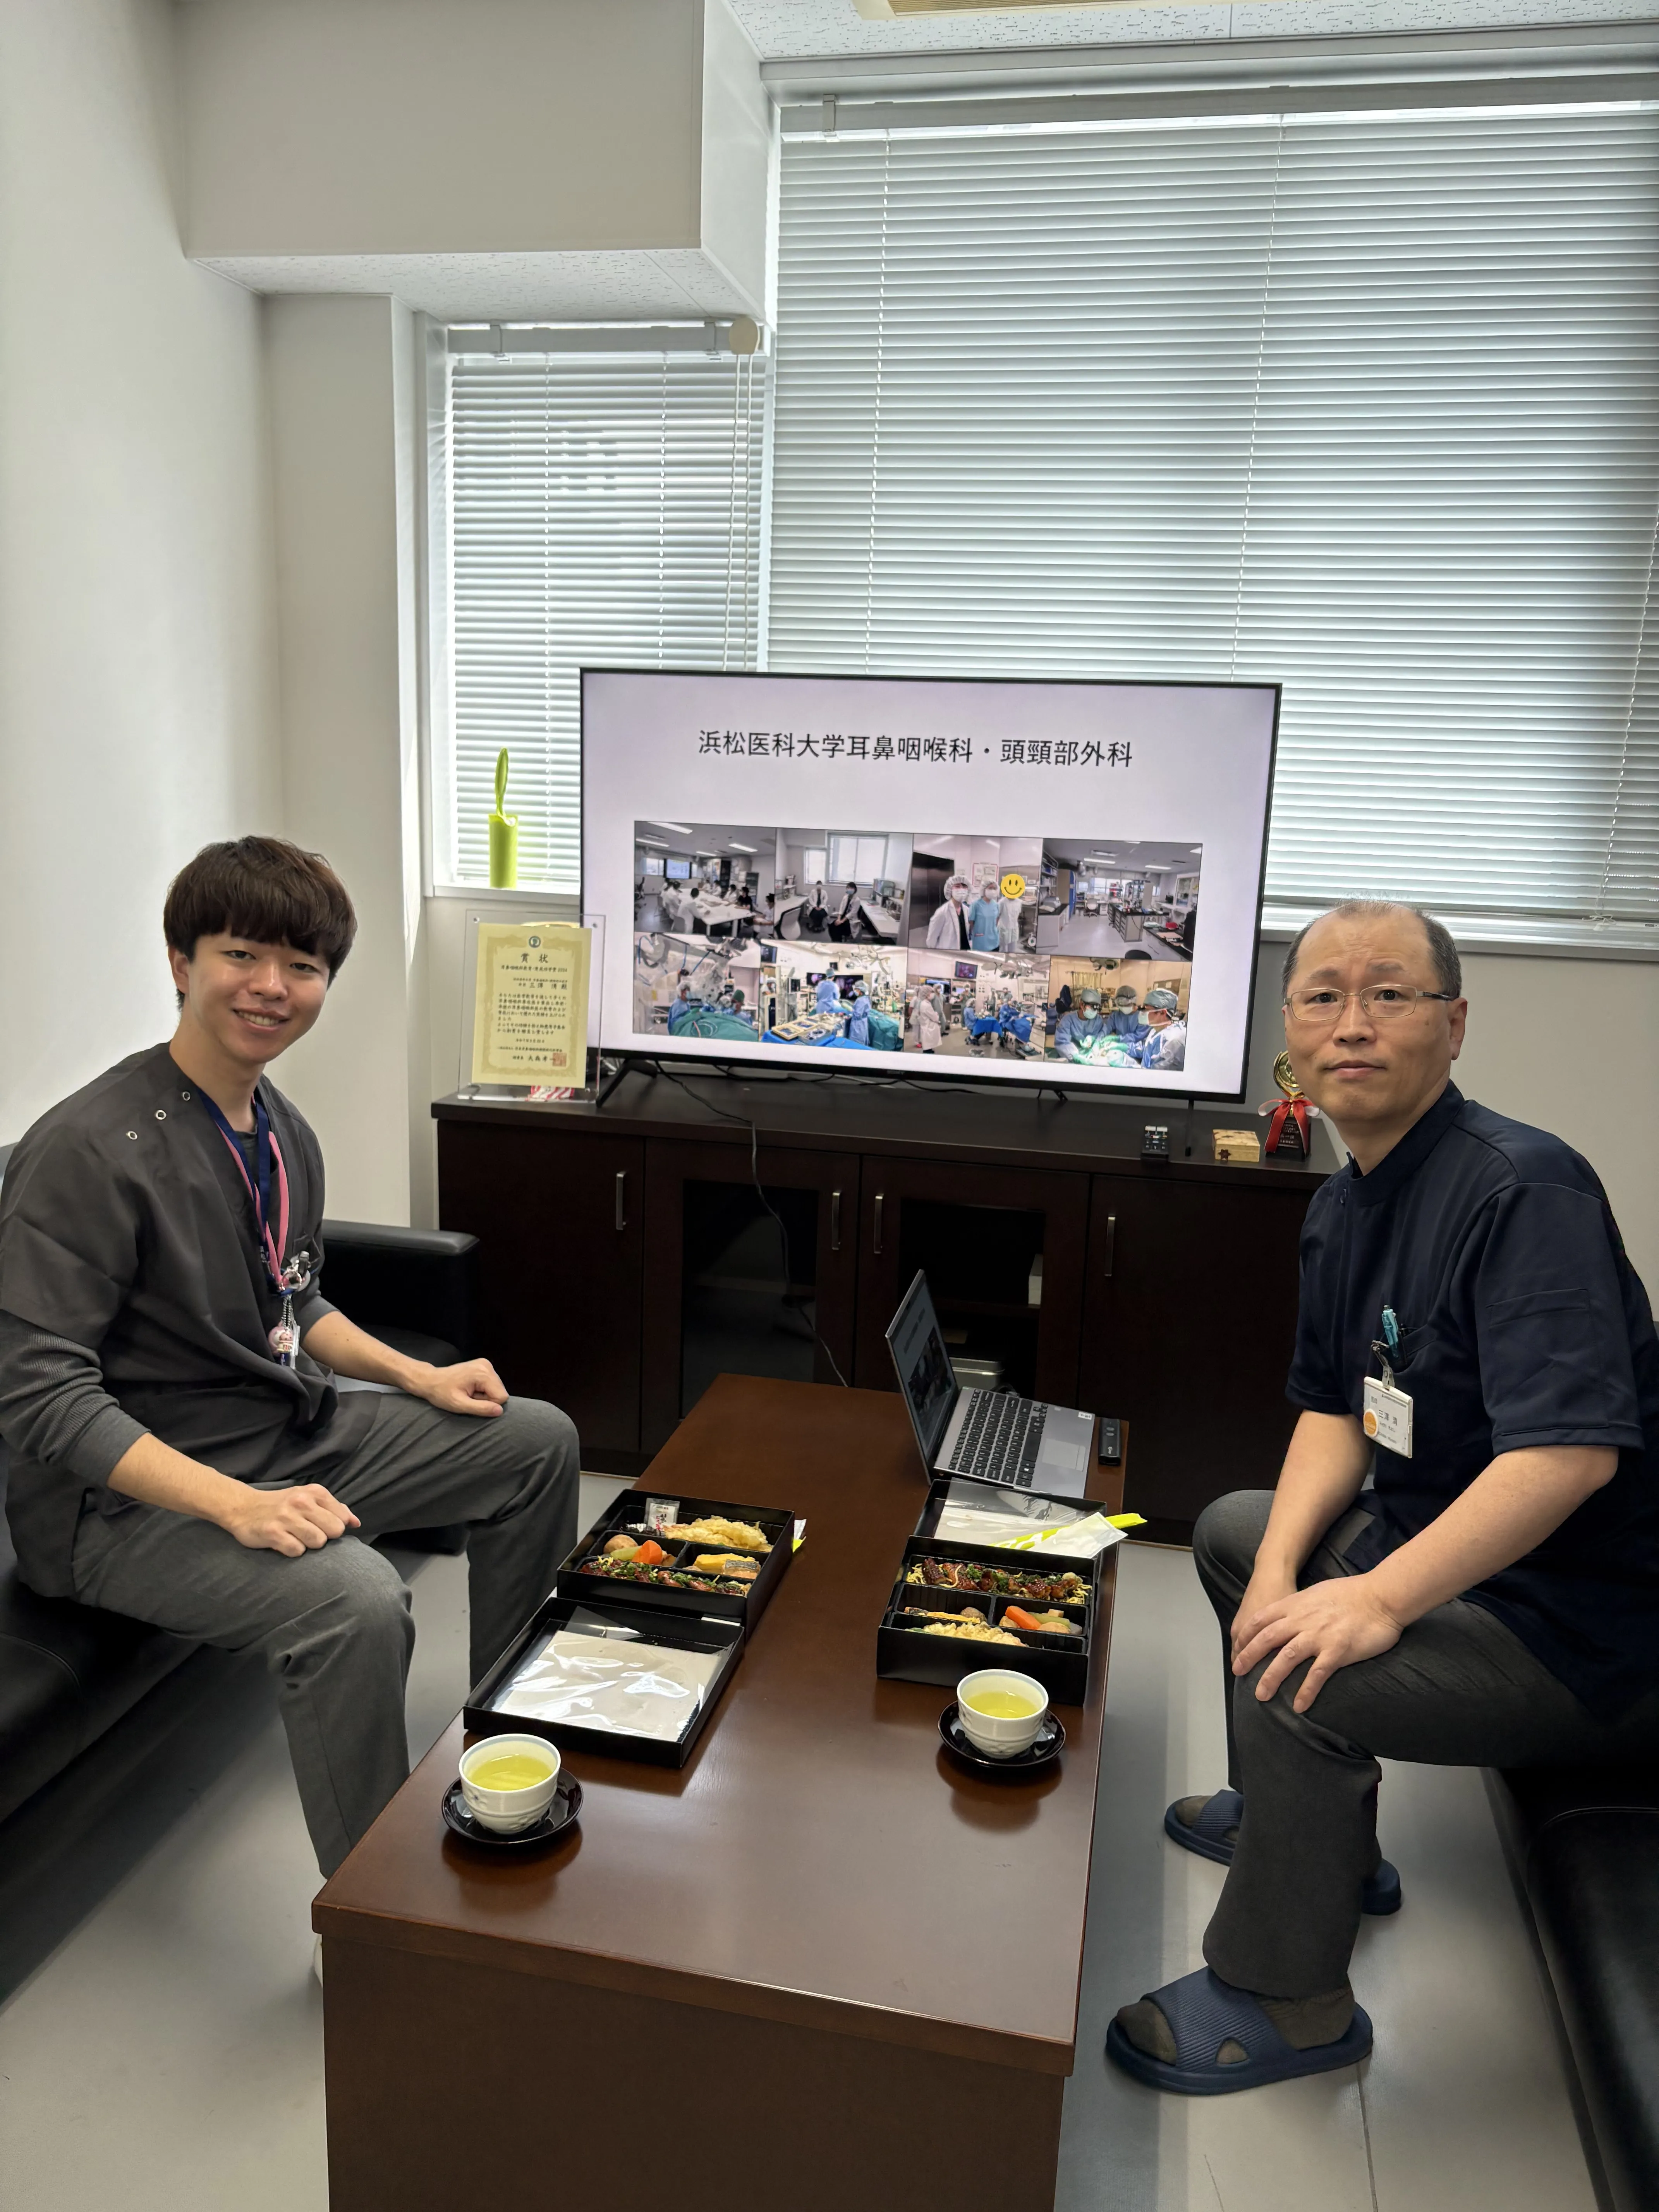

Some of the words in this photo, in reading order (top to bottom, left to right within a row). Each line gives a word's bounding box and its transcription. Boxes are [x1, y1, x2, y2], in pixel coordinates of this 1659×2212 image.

[698, 730, 1133, 768] 浜松医科大学耳鼻咽喉科・頭頸部外科
